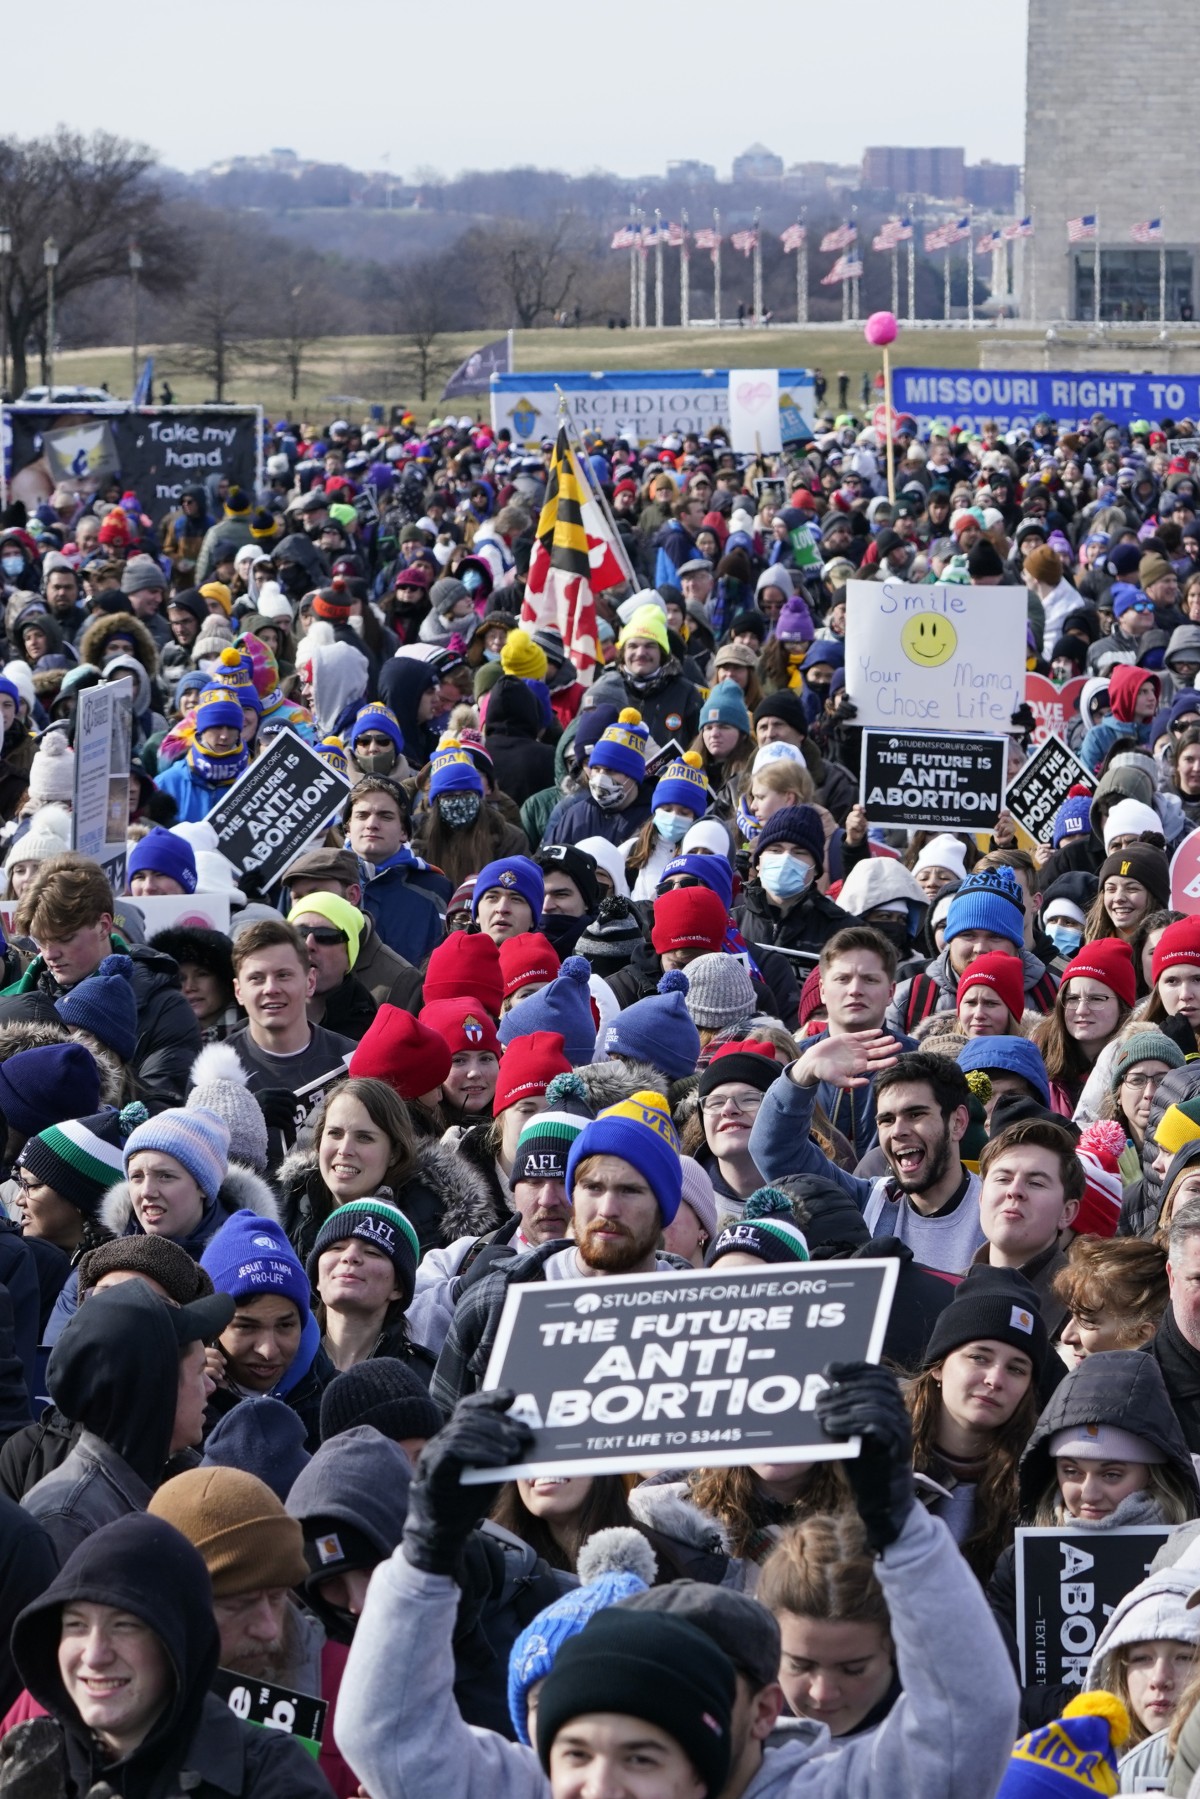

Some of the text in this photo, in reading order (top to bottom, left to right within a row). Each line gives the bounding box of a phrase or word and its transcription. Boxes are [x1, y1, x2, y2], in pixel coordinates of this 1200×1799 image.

[904, 377, 1038, 406] MISSOURI
[1051, 380, 1136, 409] RIGHT
[1148, 384, 1185, 410] TO
[148, 421, 237, 446] Take my
[165, 448, 222, 467] hand
[880, 585, 967, 614] Smile
[859, 655, 1012, 690] Your Mama
[876, 686, 940, 719] Chose
[877, 752, 992, 770] THE FUTURE IS
[897, 768, 969, 789] ANTI-
[1013, 803, 1024, 815] I
[1023, 781, 1044, 807] AM
[1040, 750, 1066, 780] THE
[218, 815, 247, 843] THE
[243, 767, 288, 818] FUTURE
[284, 753, 301, 775] IS
[866, 787, 998, 812] ABORTION
[1022, 758, 1082, 832] POST-ROE
[242, 770, 336, 874] ABORTION
[247, 782, 297, 841] ANTI-
[525, 1154, 562, 1170] AFL
[359, 1216, 395, 1246] AFL
[717, 1225, 760, 1243] AFL
[238, 1261, 292, 1278] JESUIT TAMPA
[251, 1272, 284, 1285] PRO-LIFE
[601, 1279, 827, 1309] STUDENTSFORLIFE.ORG
[539, 1302, 846, 1347] THE FUTURE IS
[583, 1337, 776, 1384] ANTI-
[586, 1428, 742, 1450] TEXT LIFE TO 53445
[1035, 1618, 1046, 1675] TEXT LIFE
